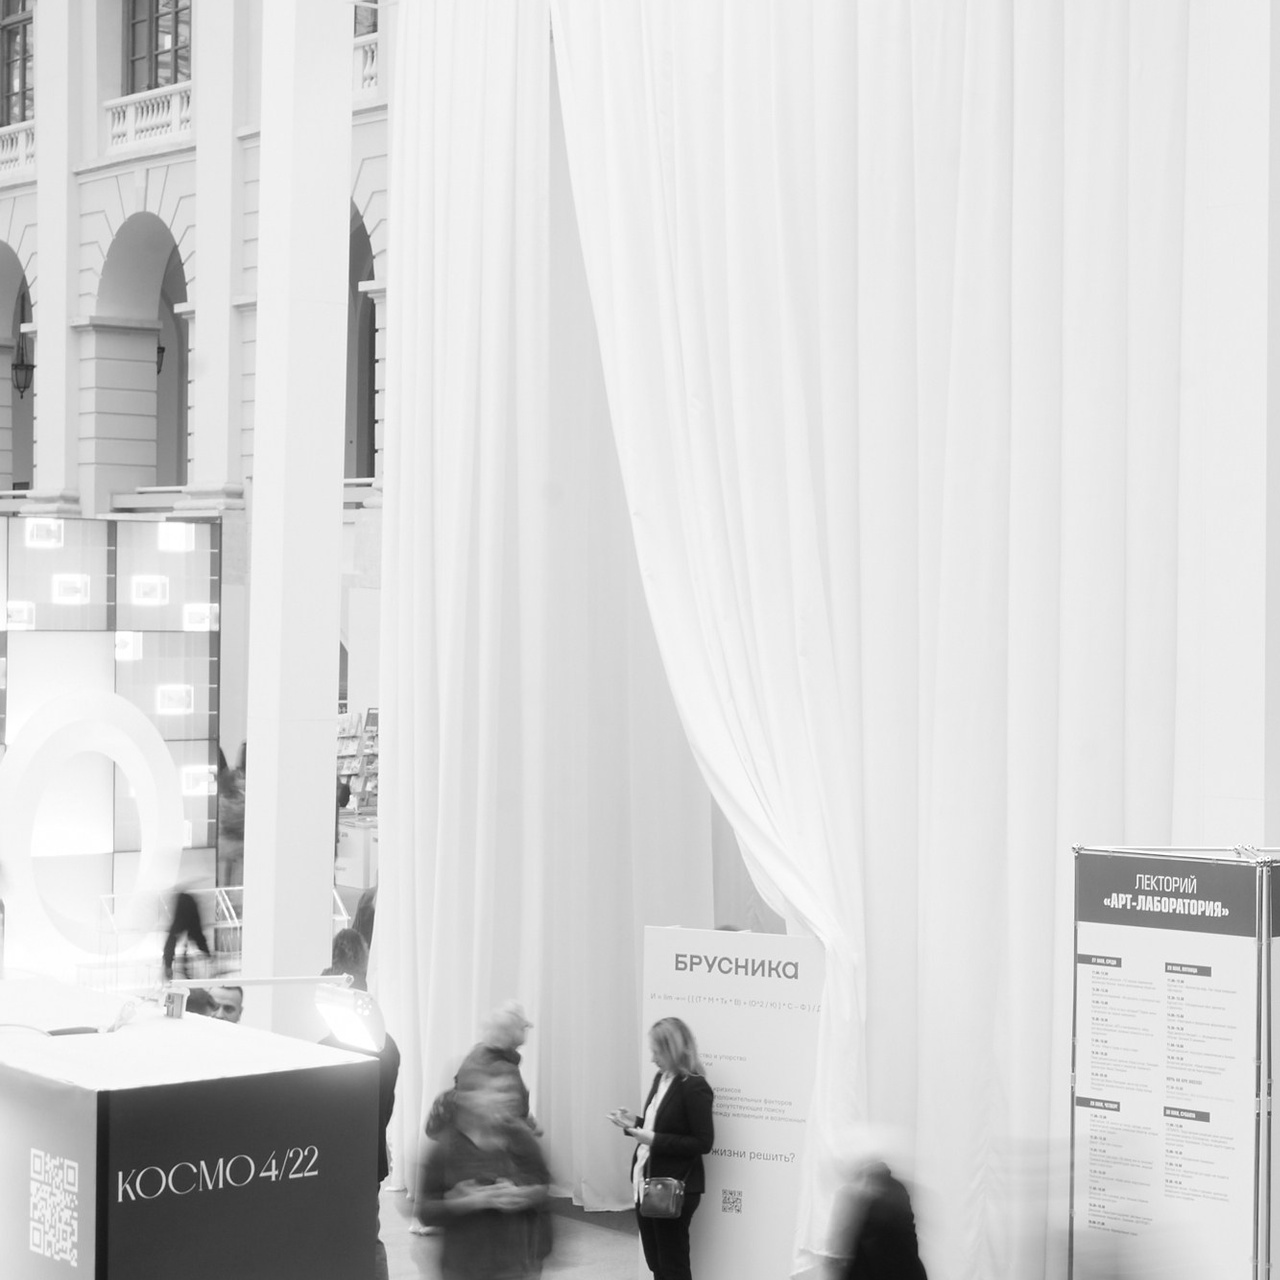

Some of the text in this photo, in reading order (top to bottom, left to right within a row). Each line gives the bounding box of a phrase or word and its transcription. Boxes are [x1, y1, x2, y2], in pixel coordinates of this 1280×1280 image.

[1135, 874, 1197, 895] ЛЕКТОРИЙ
[1103, 892, 1230, 918] «АРТ-ЛАБОРАТОРИЯ»
[749, 1151, 795, 1163] решить?
[118, 1145, 319, 1203] КОСМО 4/22
